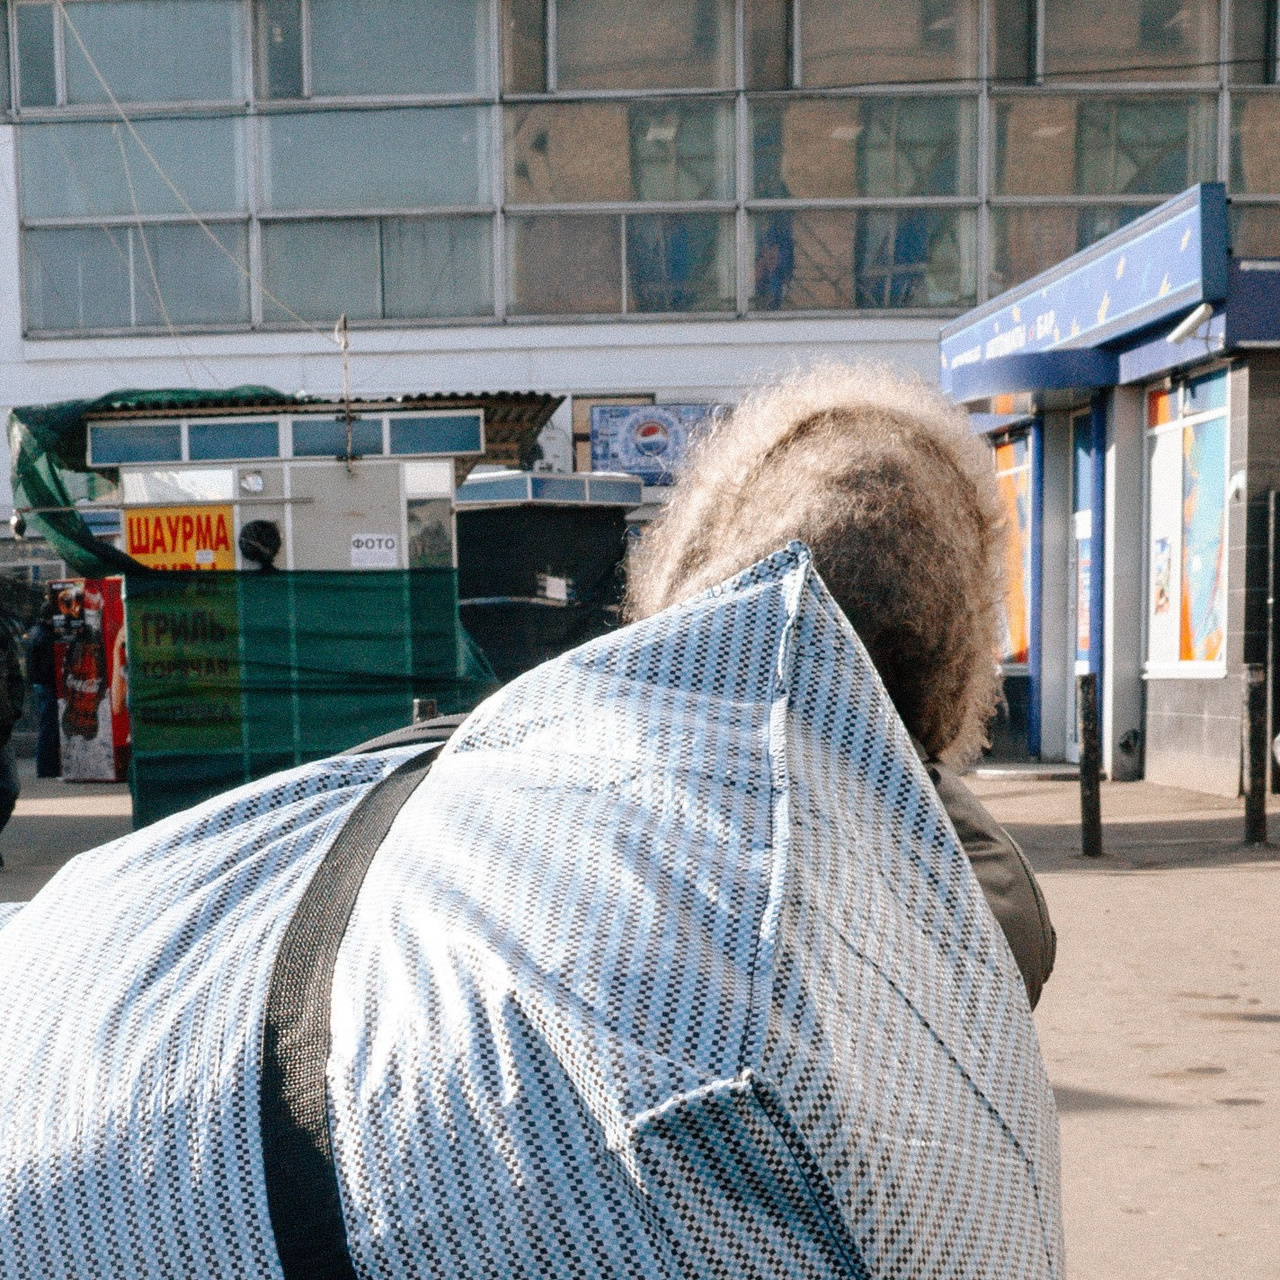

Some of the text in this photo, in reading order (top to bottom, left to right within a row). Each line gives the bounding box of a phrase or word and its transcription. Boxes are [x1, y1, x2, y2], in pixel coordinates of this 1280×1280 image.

[128, 513, 230, 554] ШАУРМА
[353, 538, 395, 549] ФОТО
[141, 610, 226, 646] ГРИЛЬ
